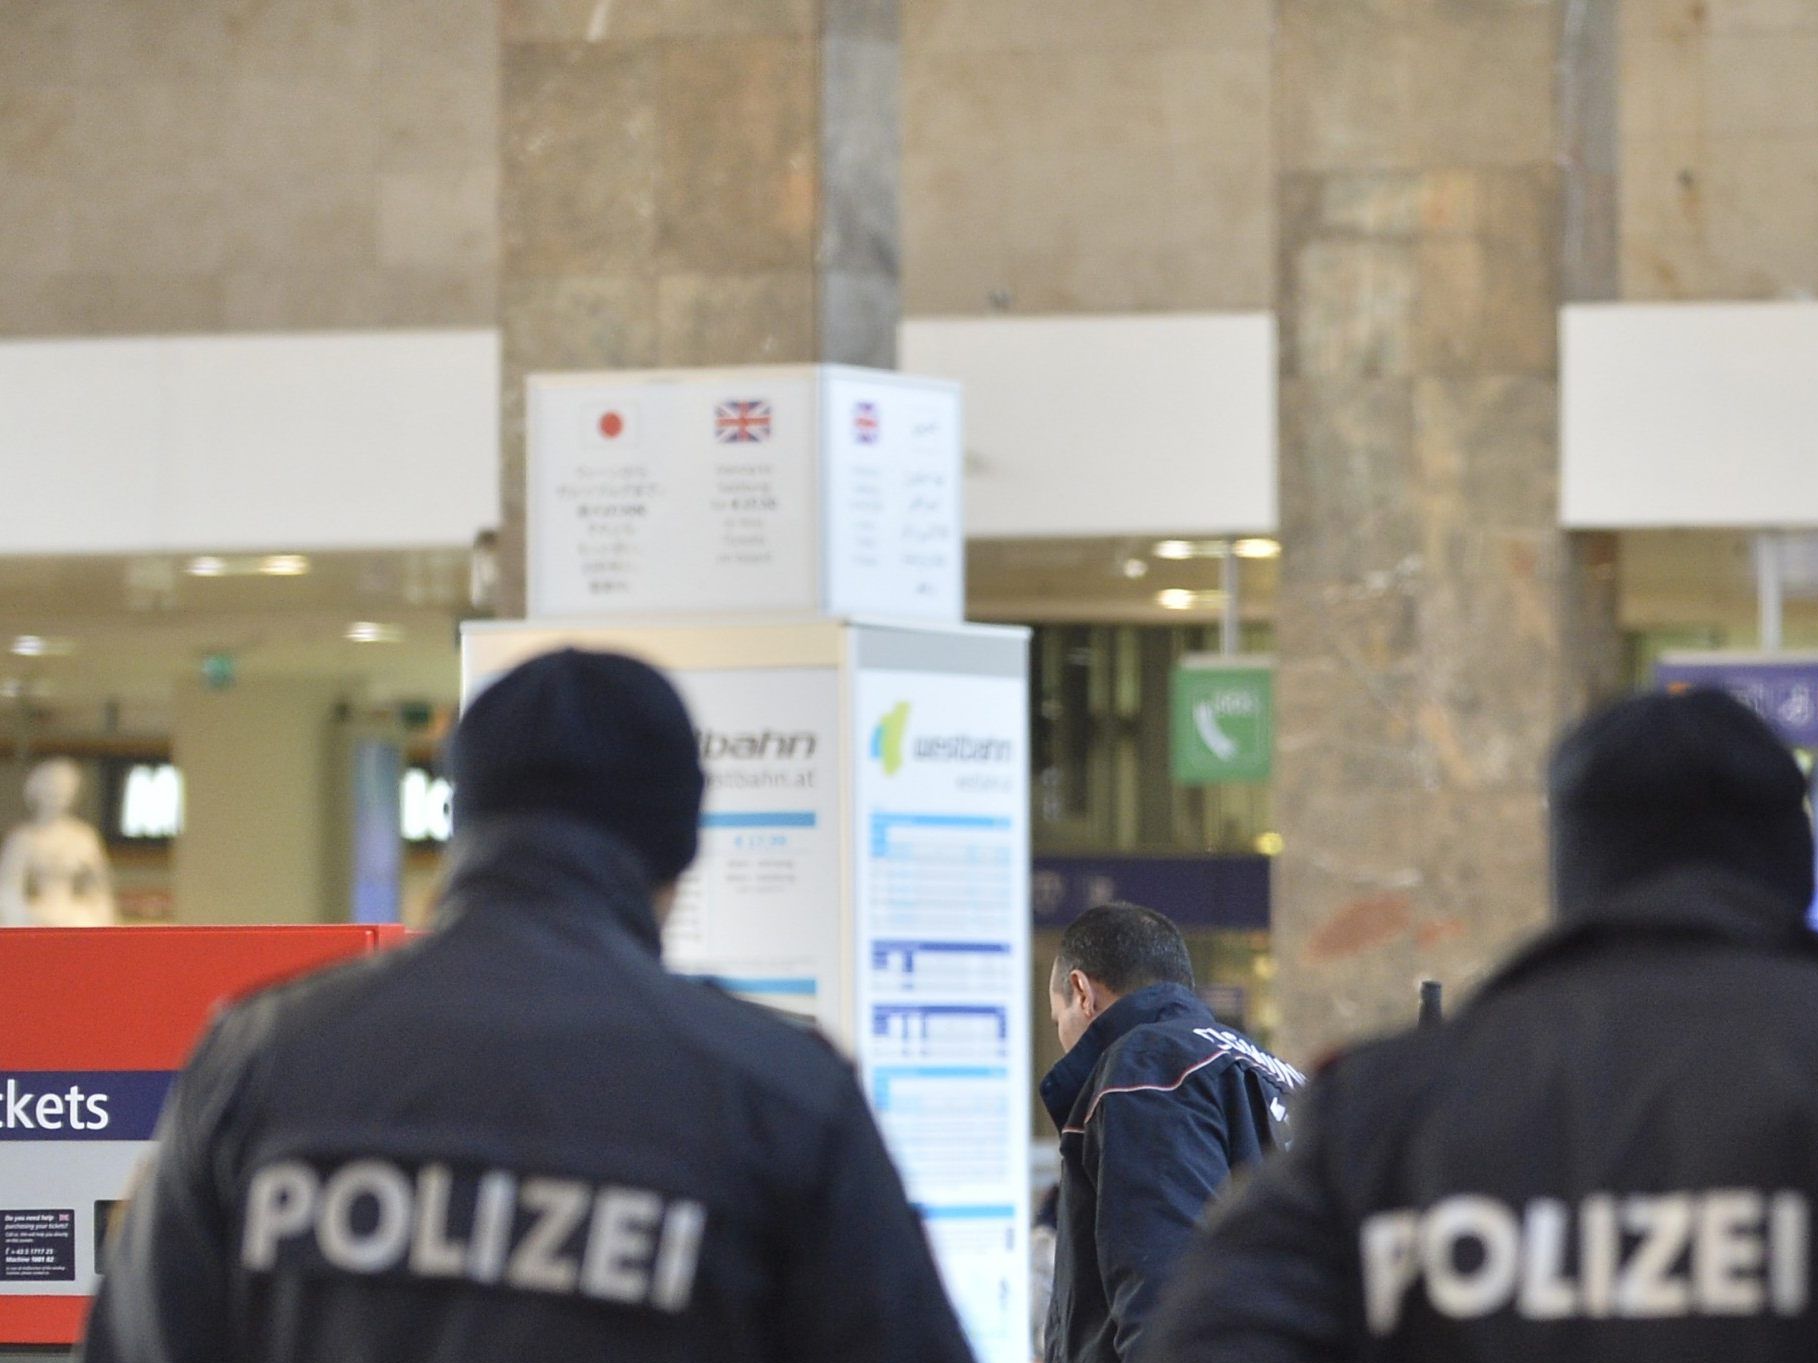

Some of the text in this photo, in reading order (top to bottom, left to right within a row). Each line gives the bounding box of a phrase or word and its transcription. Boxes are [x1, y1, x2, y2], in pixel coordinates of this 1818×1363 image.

[697, 730, 816, 760] bahn
[0, 1079, 109, 1130] kets
[240, 1160, 707, 1313] POLIZEI
[1360, 1189, 1812, 1338] POLIZEI
